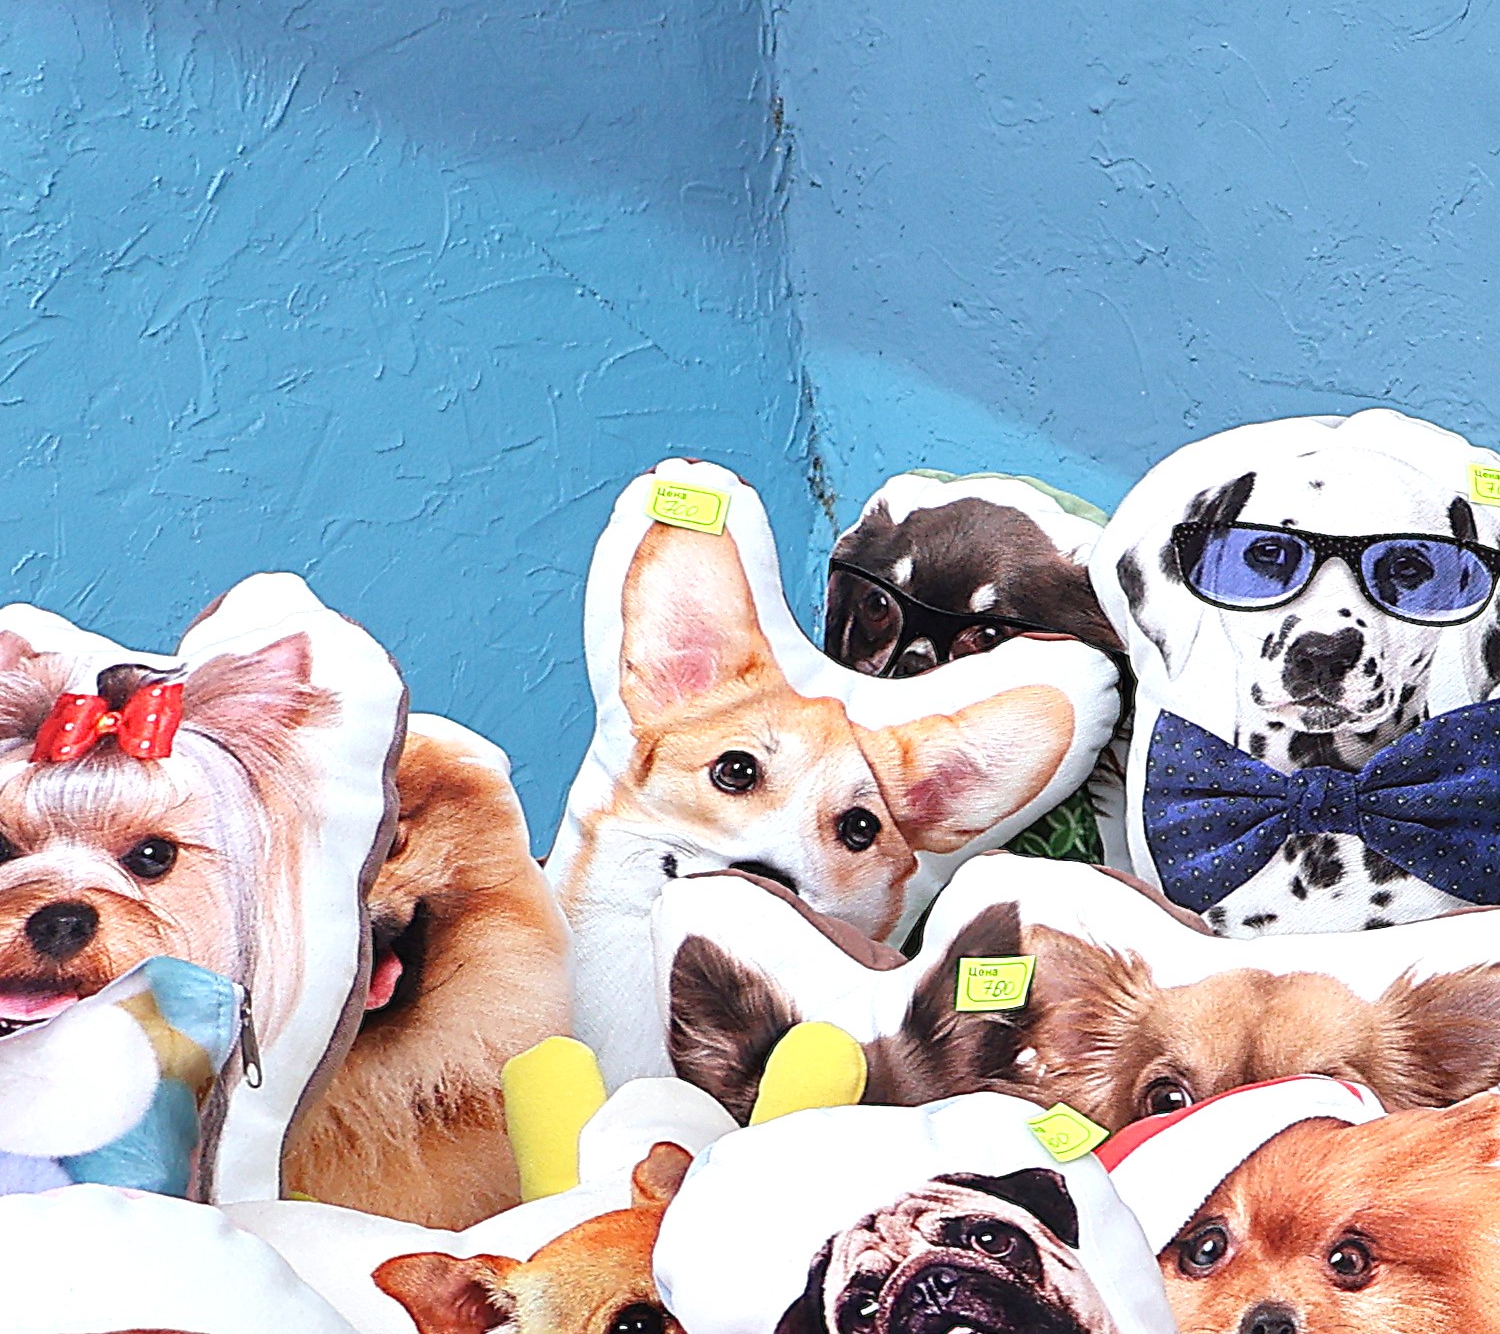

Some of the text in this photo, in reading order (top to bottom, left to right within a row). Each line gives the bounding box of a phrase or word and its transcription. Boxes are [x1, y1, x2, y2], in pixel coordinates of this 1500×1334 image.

[662, 500, 698, 517] 700
[968, 967, 998, 977] Цена
[1047, 1132, 1069, 1148] 00
